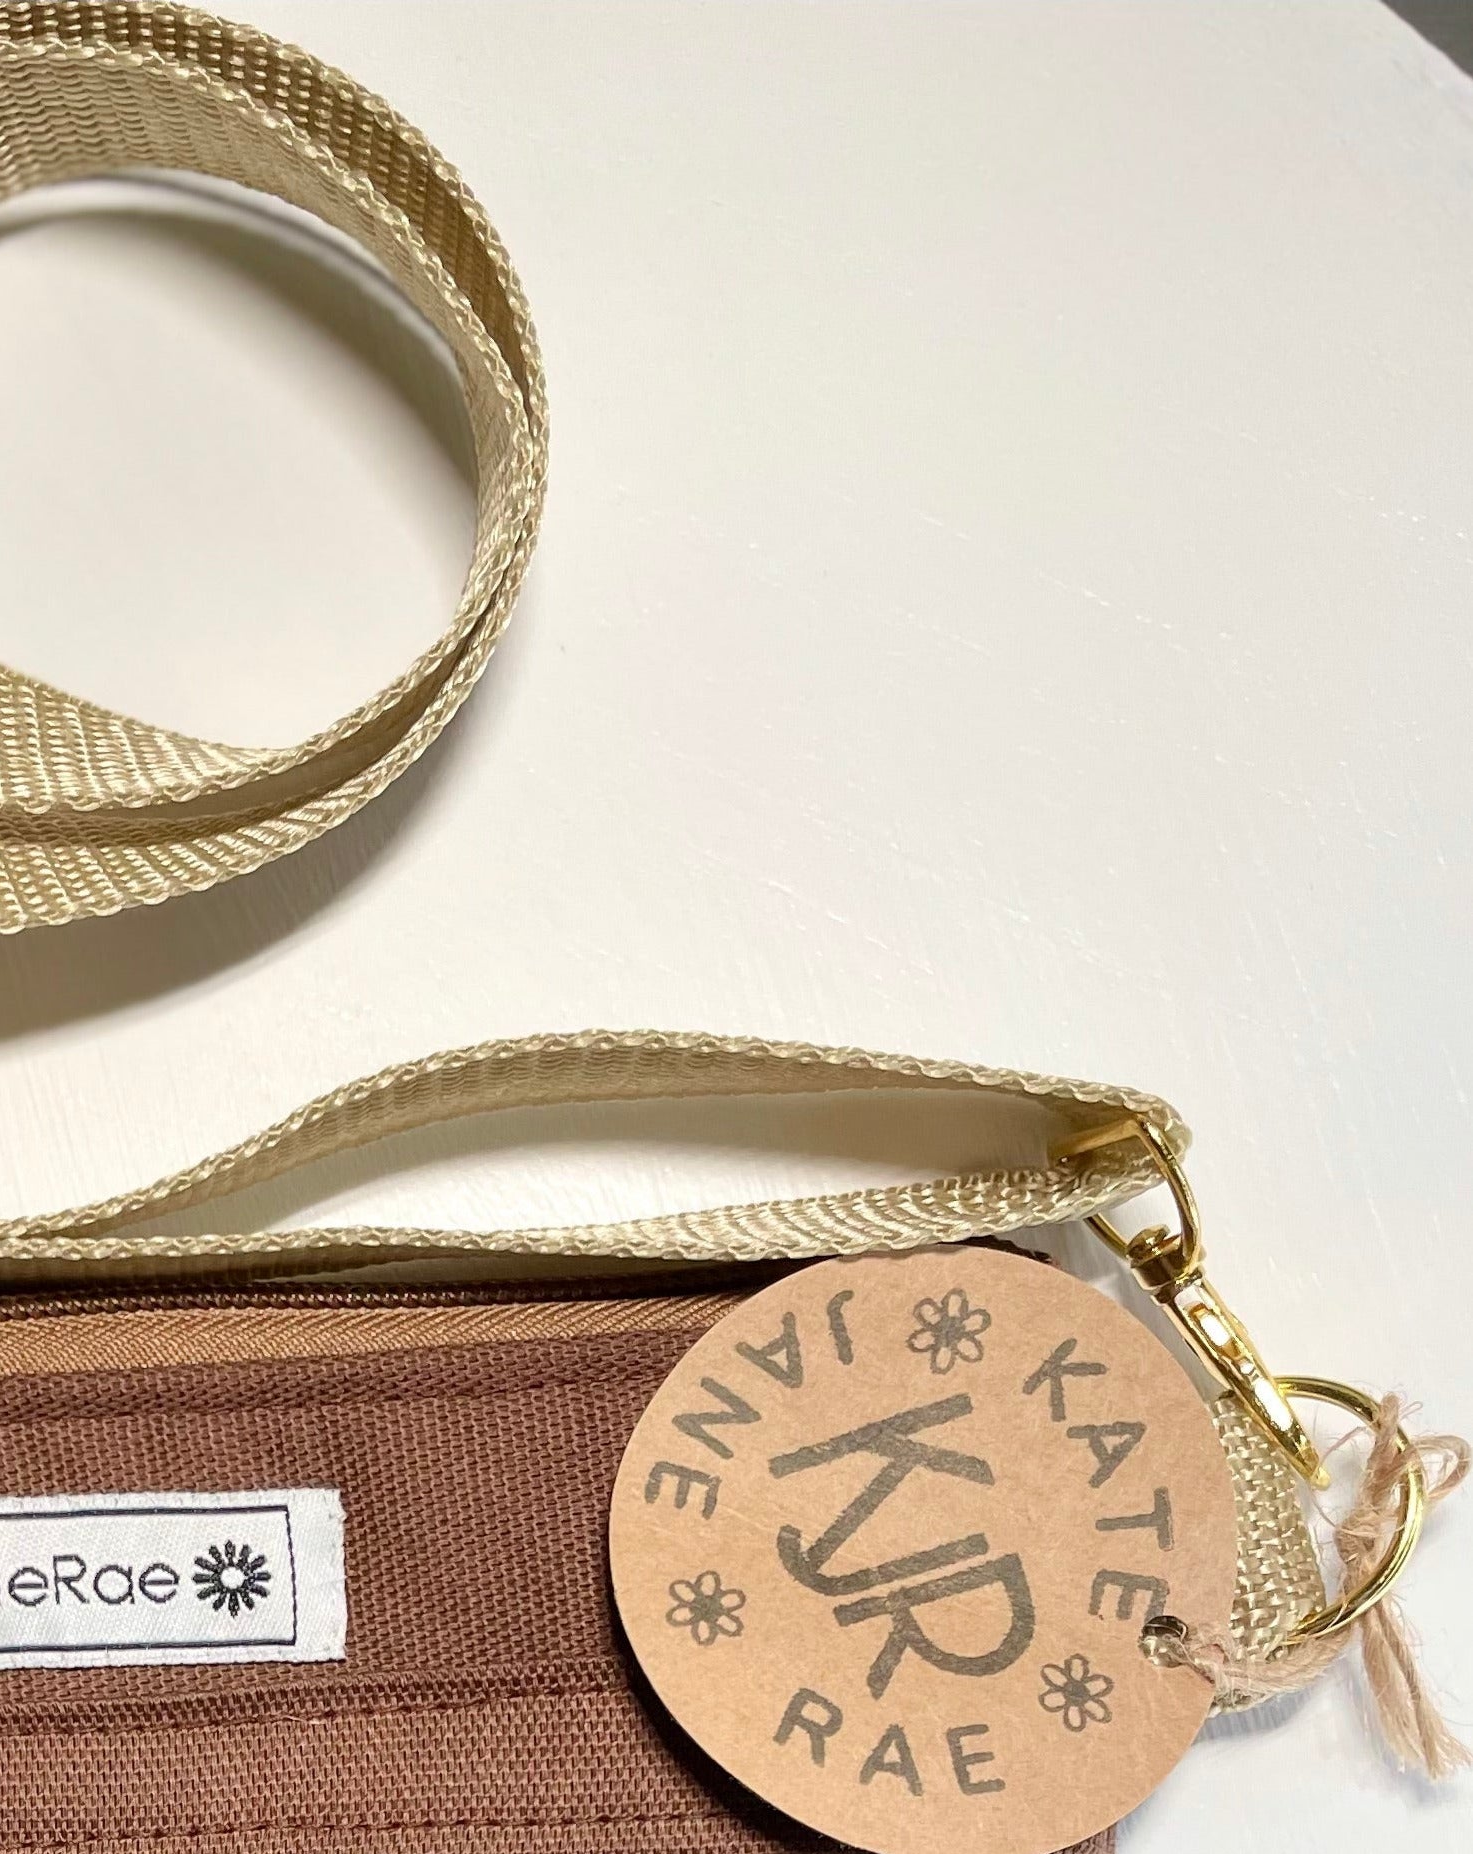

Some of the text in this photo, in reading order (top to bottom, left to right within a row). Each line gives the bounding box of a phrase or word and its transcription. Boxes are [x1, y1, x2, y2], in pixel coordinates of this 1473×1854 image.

[644, 1289, 1005, 1797] JANE RAE
[1023, 1338, 1175, 1623] KATE
